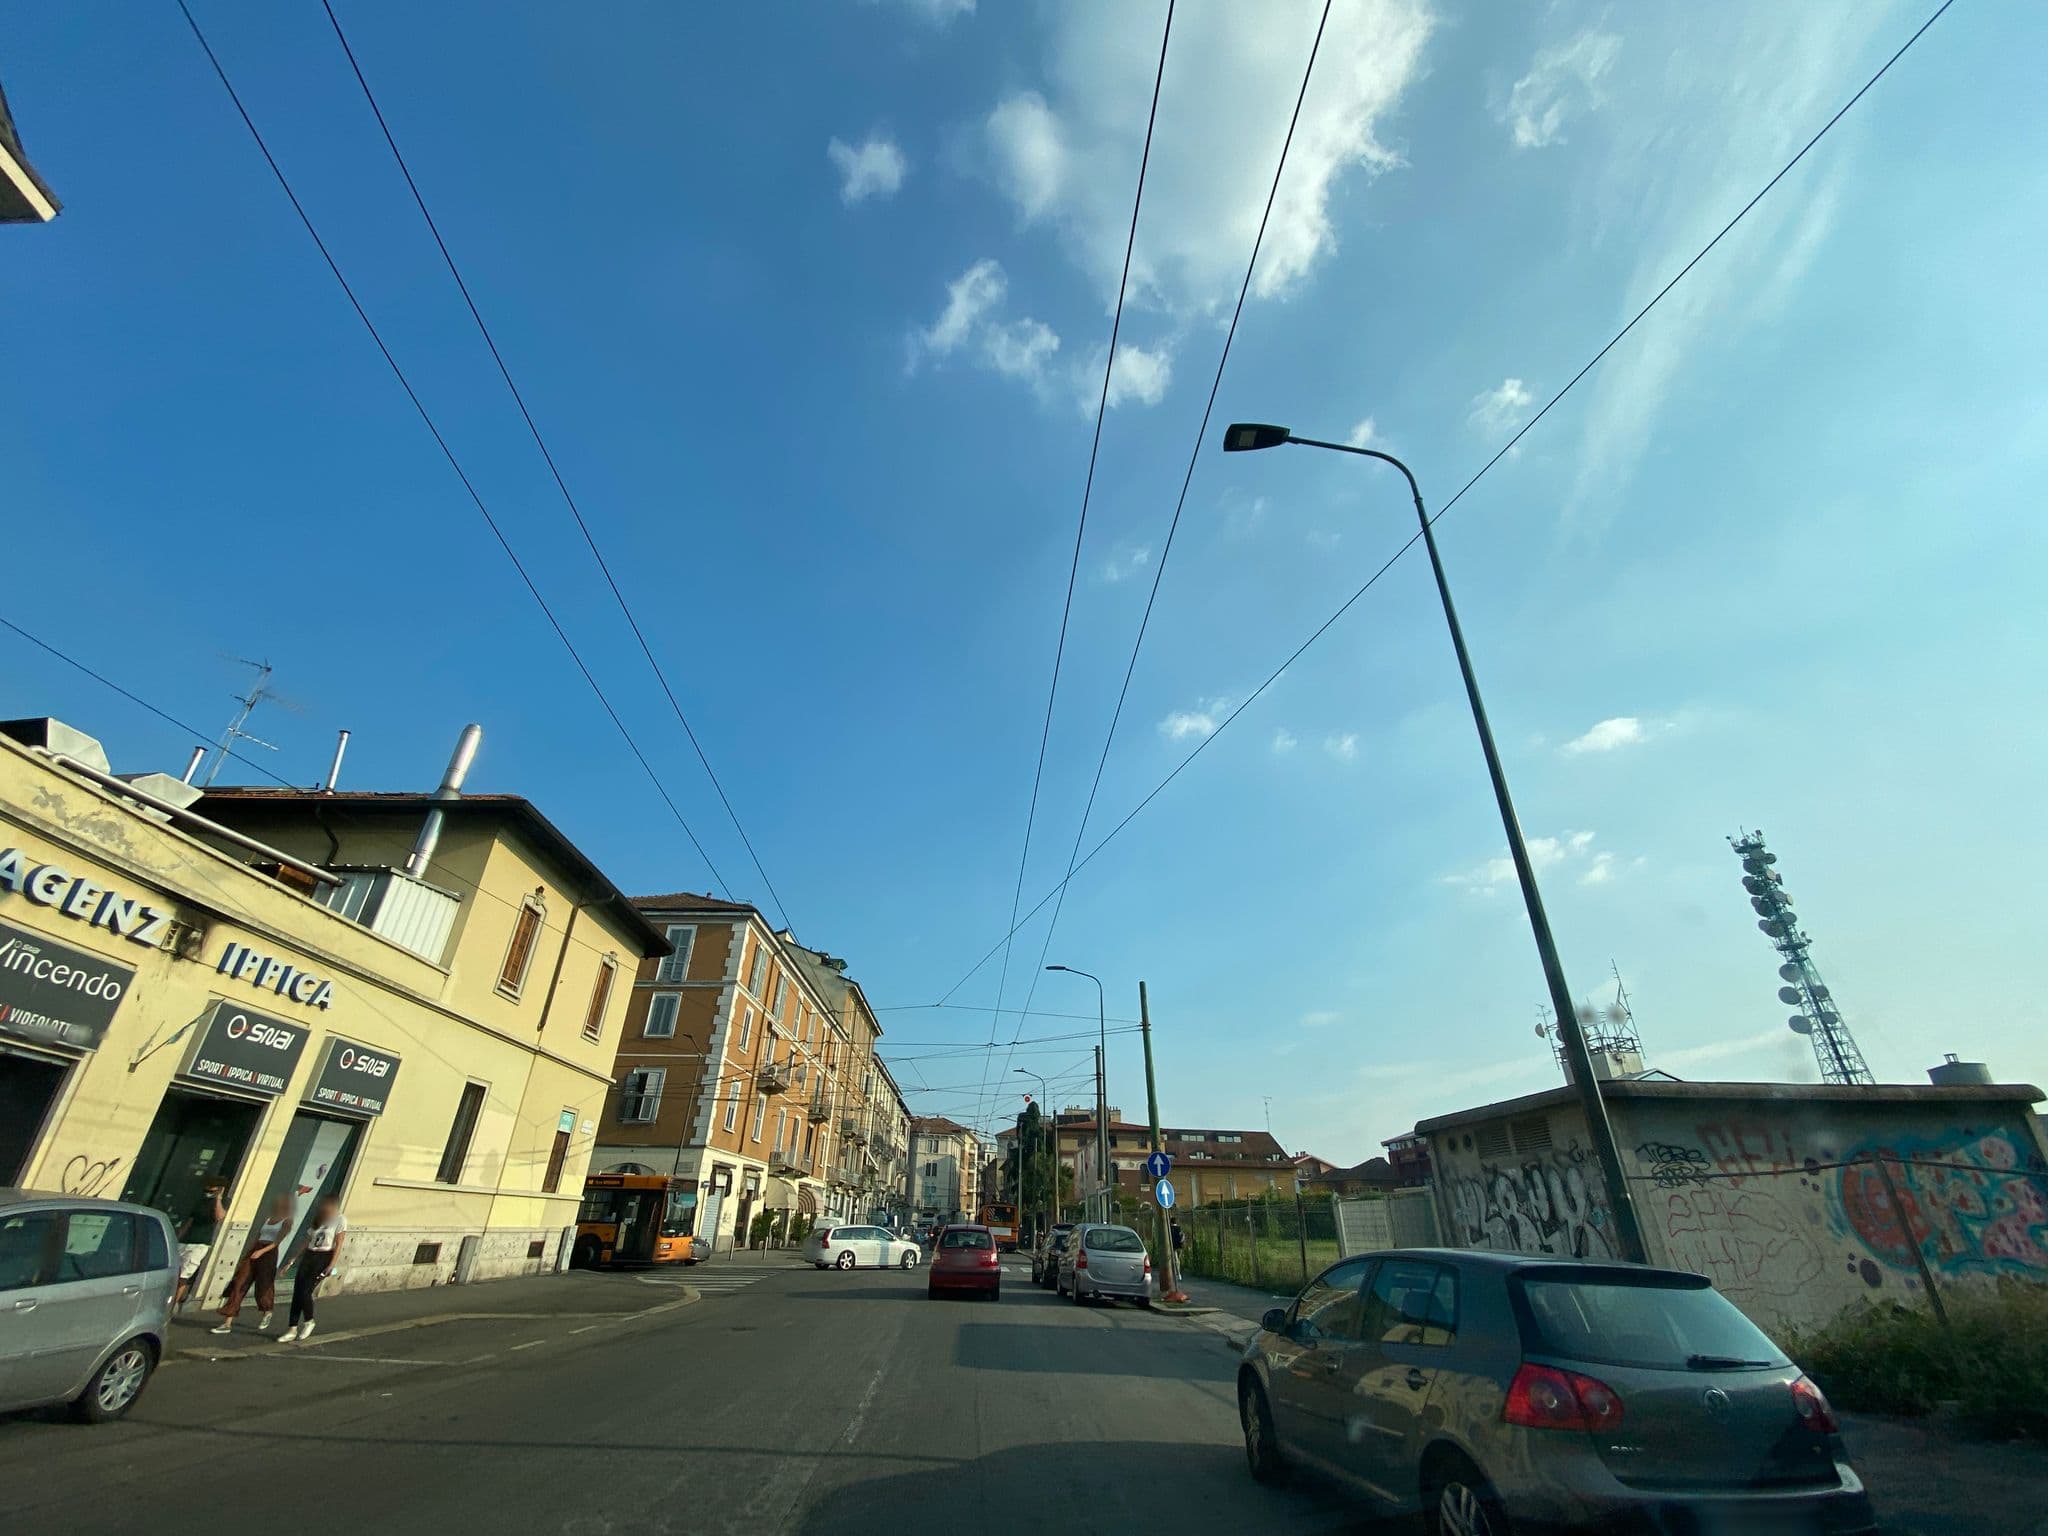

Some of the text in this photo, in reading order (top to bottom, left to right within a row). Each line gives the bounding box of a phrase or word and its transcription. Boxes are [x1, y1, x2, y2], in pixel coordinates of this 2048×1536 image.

[0, 848, 174, 947] AGENZ
[216, 943, 335, 1010] IPPICA
[198, 1059, 285, 1090] SPORT IPPICA VIRTUAL
[318, 1087, 338, 1100] SPORT
